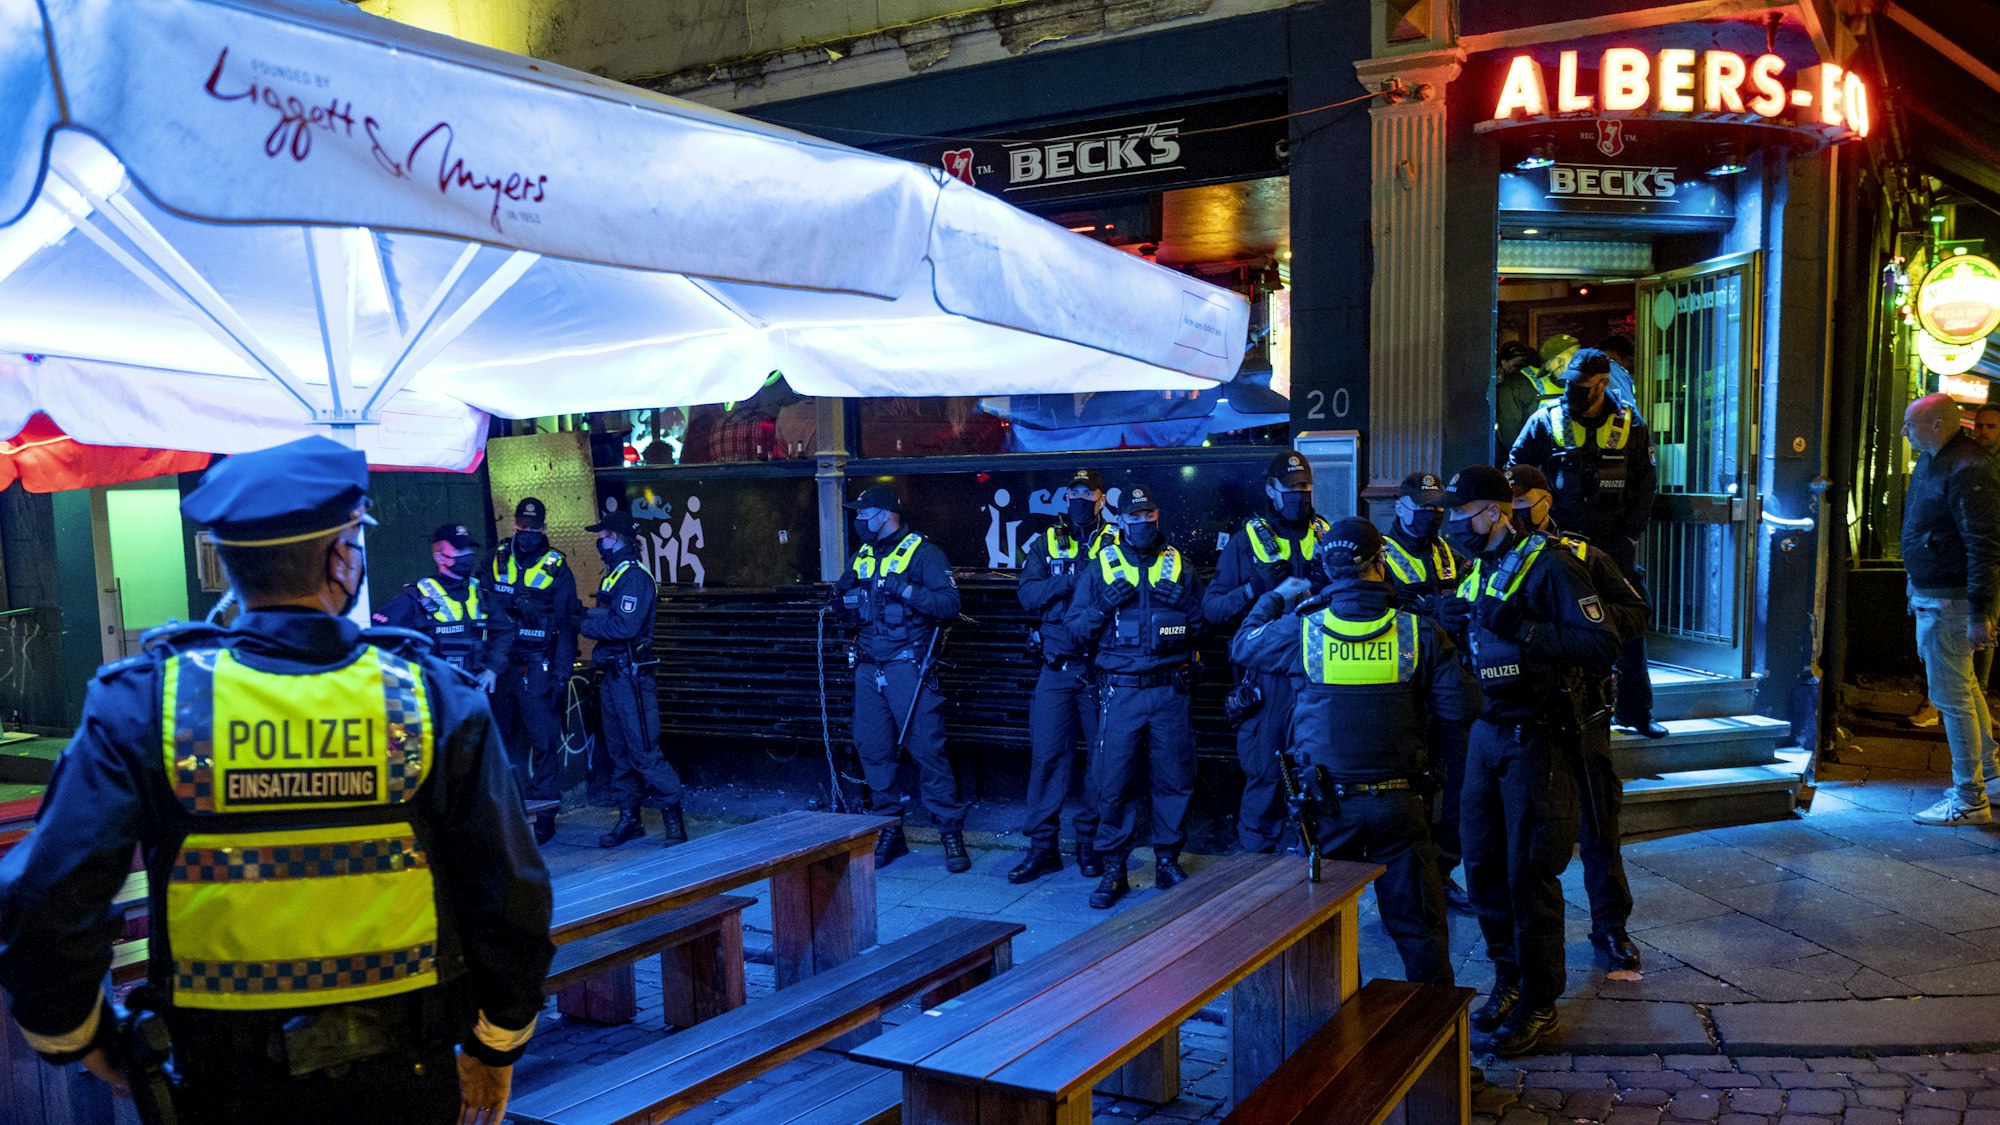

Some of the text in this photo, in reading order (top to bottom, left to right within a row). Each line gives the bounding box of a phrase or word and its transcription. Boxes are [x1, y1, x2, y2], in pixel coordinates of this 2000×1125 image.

[204, 46, 355, 161] Liggett
[407, 121, 548, 233] Myers
[1008, 122, 1181, 184] BECK'S
[1549, 166, 1677, 198] BECK'S
[1306, 387, 1349, 419] 20
[1599, 480, 1624, 488] POLIZEI
[1323, 540, 1359, 551] POLIZEI
[435, 624, 465, 634] POLIZEI
[519, 628, 545, 638] POLIZEI
[1159, 625, 1186, 636] POLIZEI
[1329, 641, 1392, 661] POLIZEI
[1480, 664, 1520, 679] POLIZEI
[228, 718, 374, 760] POLIZEI
[228, 771, 375, 799] EINSATZLEITUNG
